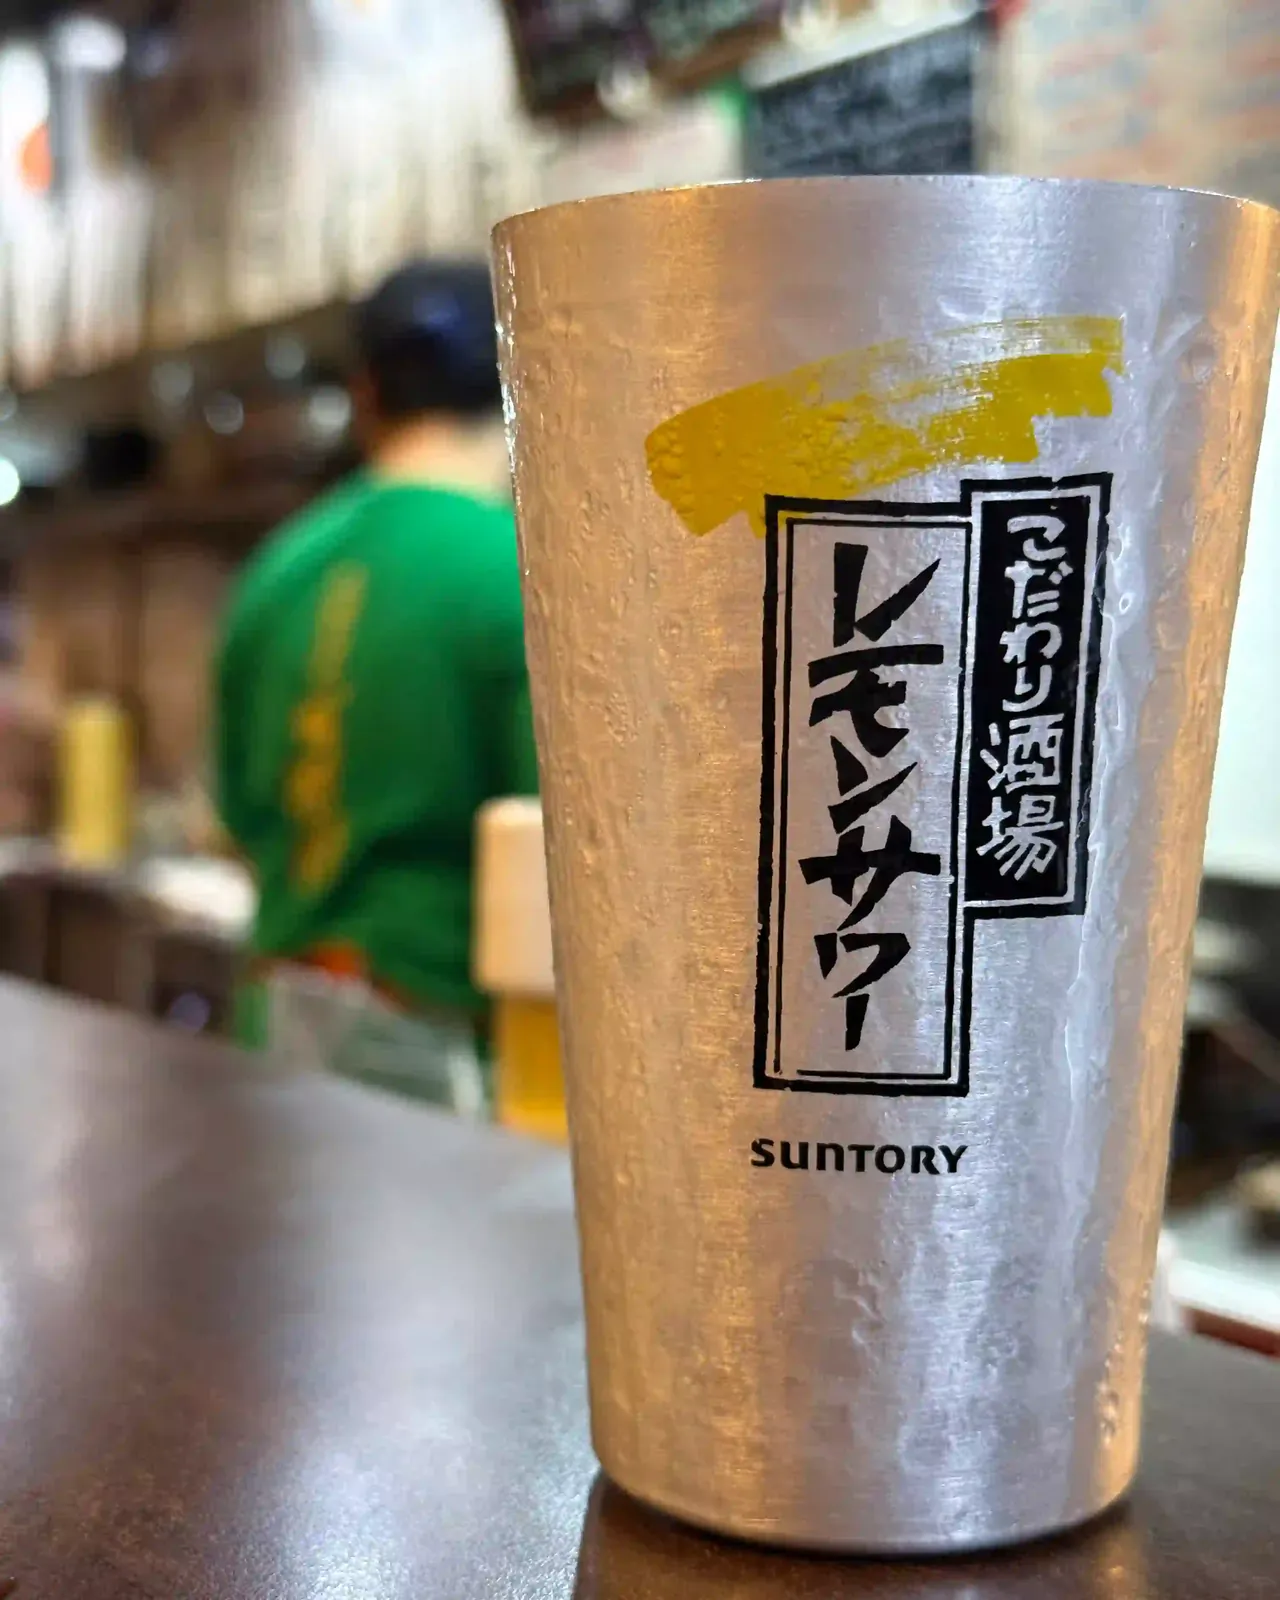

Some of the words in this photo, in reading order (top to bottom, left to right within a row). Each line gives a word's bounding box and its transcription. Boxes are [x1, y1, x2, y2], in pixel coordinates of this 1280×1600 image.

[798, 542, 944, 1052] レモンサワー
[976, 514, 1074, 882] こだわり酒場
[750, 1137, 969, 1176] SUNTORY
